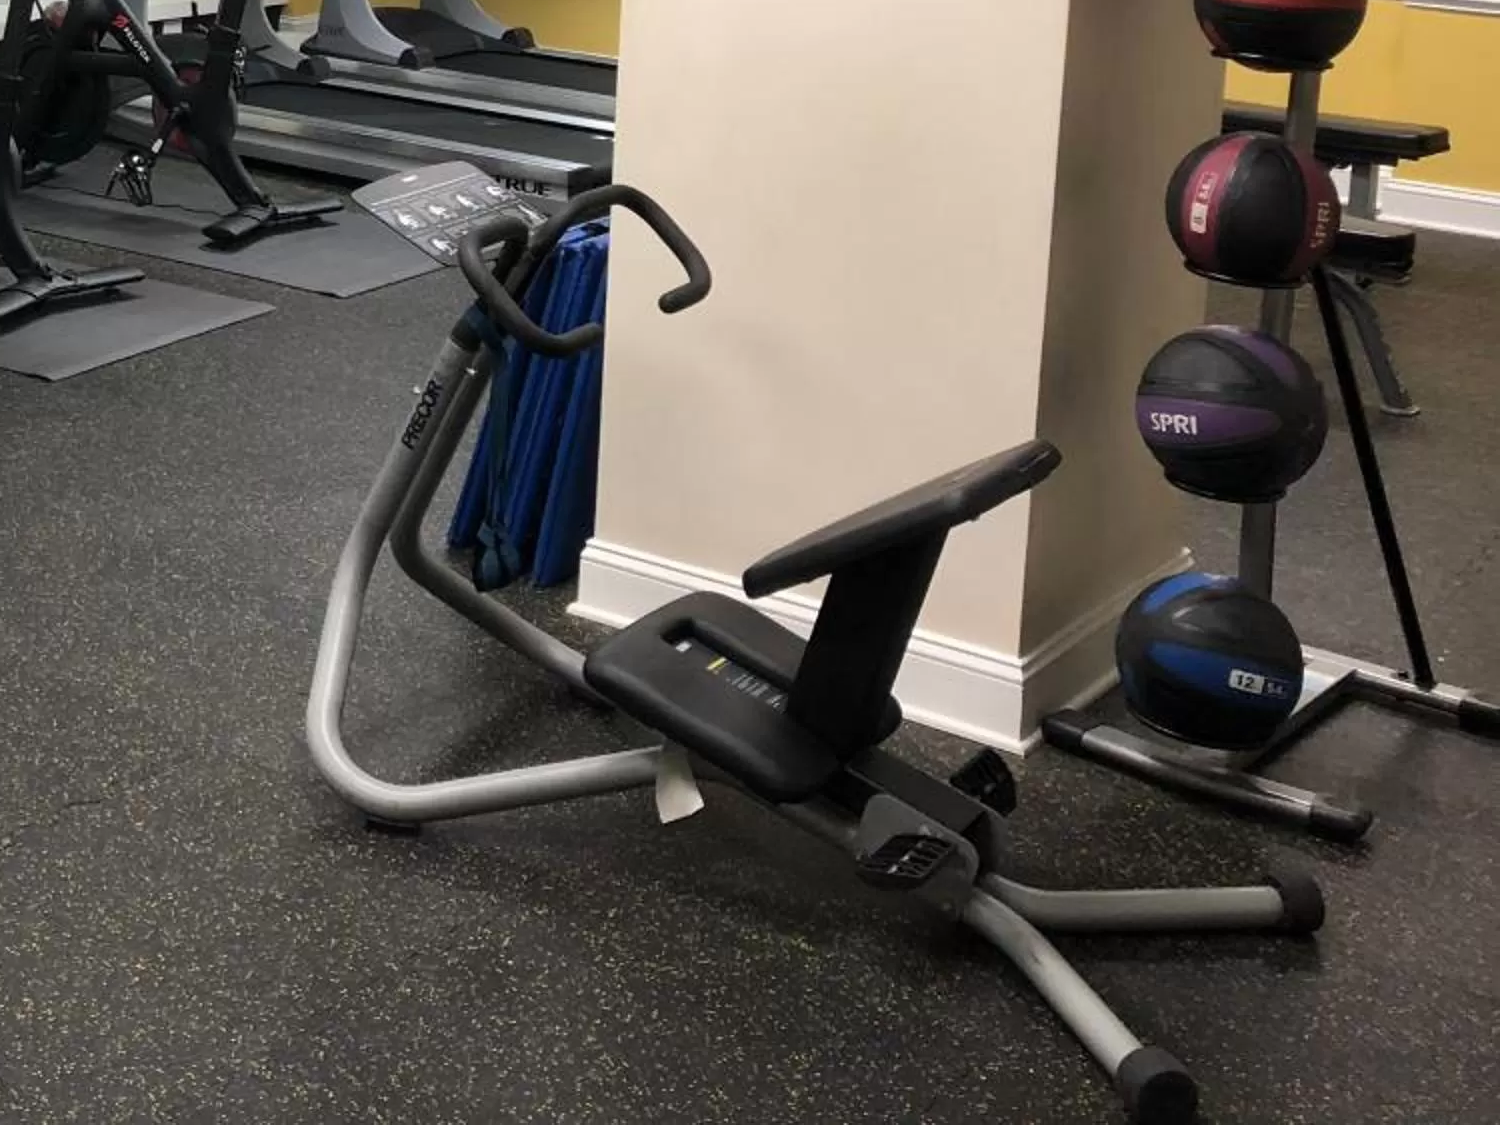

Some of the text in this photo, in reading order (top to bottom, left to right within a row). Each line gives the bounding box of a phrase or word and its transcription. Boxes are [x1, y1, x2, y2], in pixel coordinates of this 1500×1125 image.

[122, 26, 150, 63] PELOTON
[495, 176, 553, 196] RUE
[1309, 202, 1331, 248] SPRI
[402, 380, 443, 450] PRECOR
[1150, 412, 1198, 435] SPRI
[1236, 674, 1256, 690] 12
